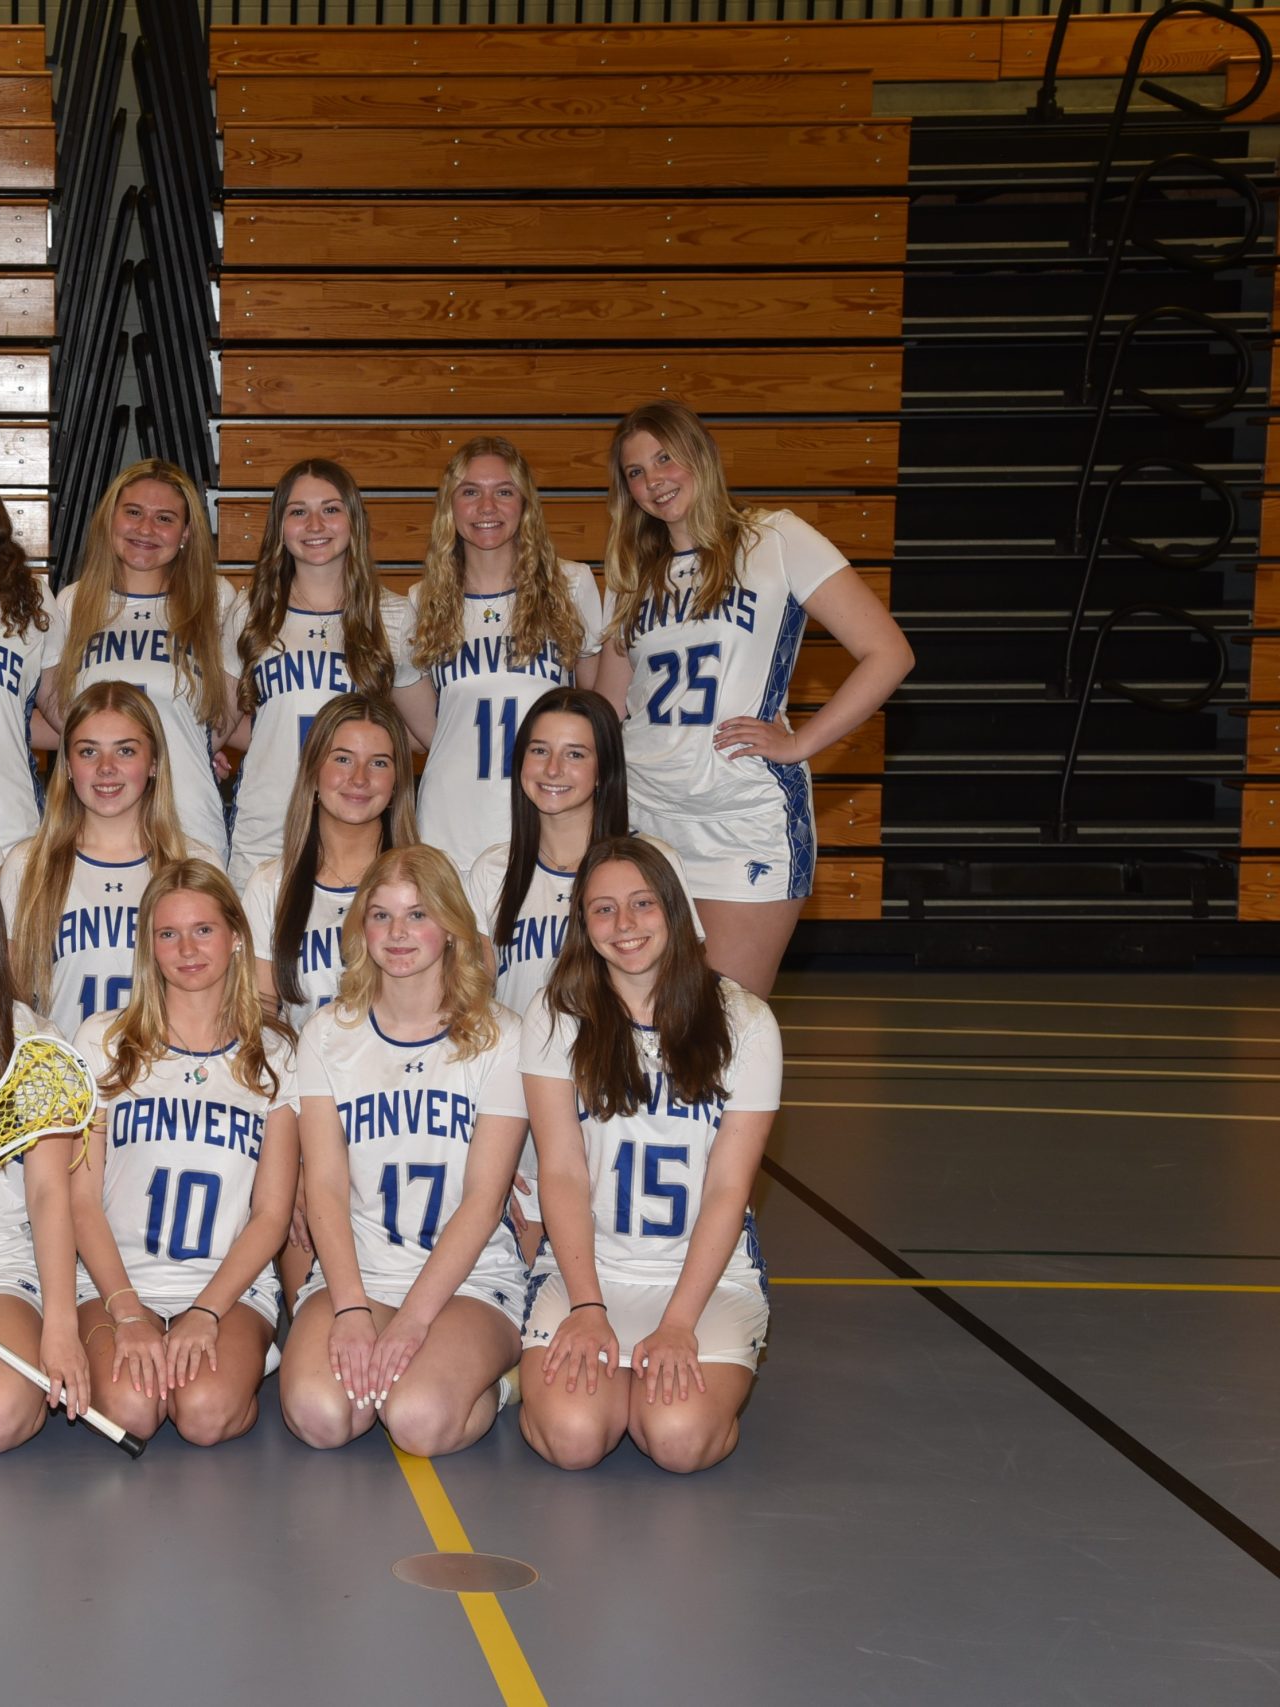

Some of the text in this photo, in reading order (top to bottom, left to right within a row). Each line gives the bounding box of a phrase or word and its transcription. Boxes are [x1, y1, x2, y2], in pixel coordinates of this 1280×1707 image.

[253, 650, 360, 708] DANVE
[646, 640, 722, 726] 25
[473, 696, 518, 780] 11
[50, 905, 140, 964] ANVE
[112, 1096, 265, 1163] DANVERS
[144, 1165, 223, 1263] 10
[376, 1161, 448, 1251] 17
[610, 1138, 691, 1238] 15
